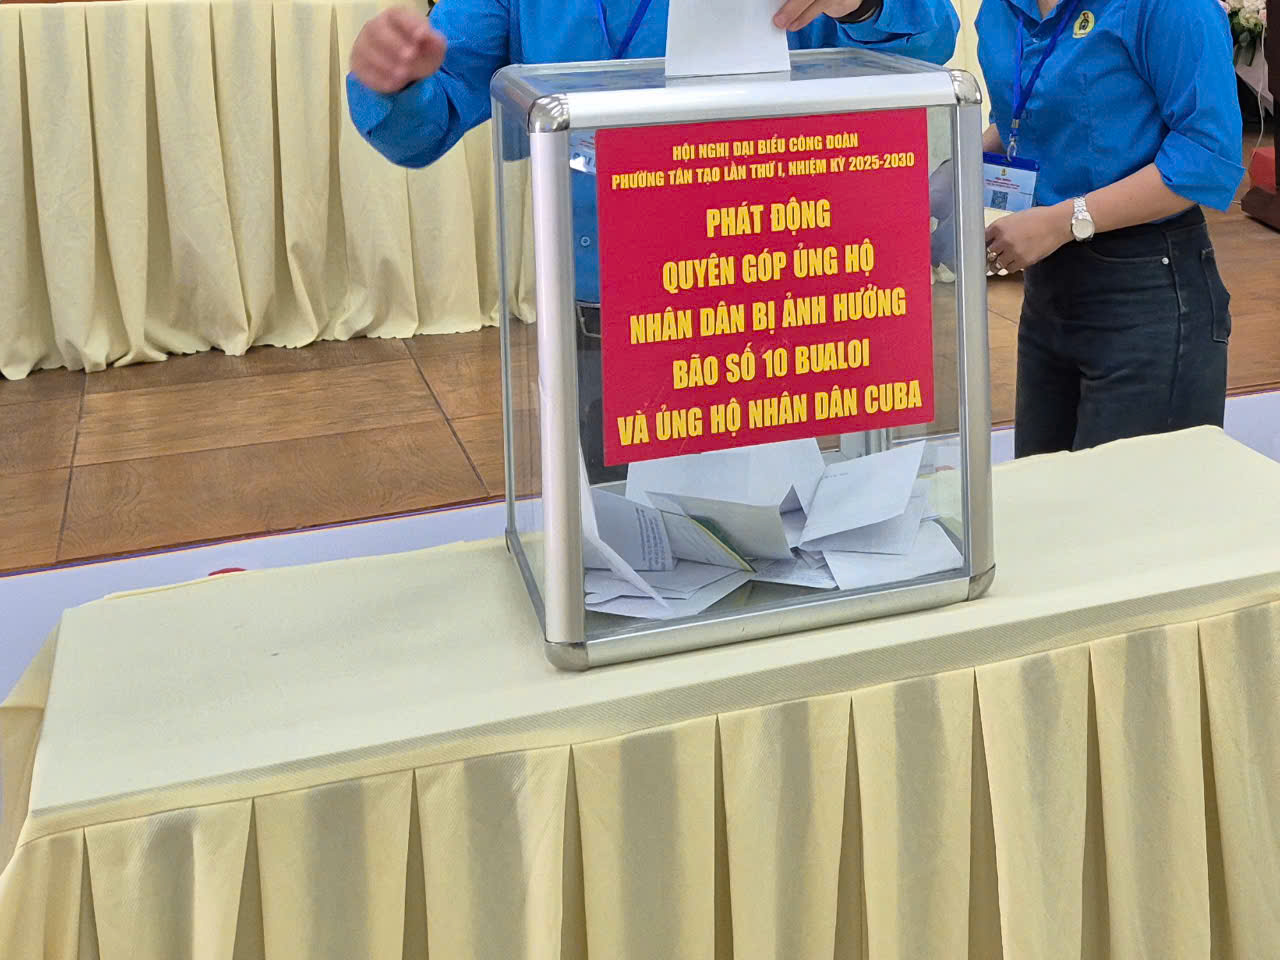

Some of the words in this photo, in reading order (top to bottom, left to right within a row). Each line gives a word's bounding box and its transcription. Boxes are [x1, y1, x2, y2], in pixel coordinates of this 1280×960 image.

[611, 170, 664, 190] PHƯỜNG
[668, 167, 693, 185] TÂN
[696, 166, 721, 185] TẠO
[749, 161, 776, 179] THỨ
[788, 157, 827, 177] NHIỆM
[848, 152, 915, 171] 2025-2030
[673, 142, 694, 163] HỘI
[698, 142, 729, 159] NGHỊ
[757, 133, 786, 154] BIỂU
[789, 135, 822, 152] CÔNG
[706, 200, 764, 237] PHÁT
[770, 196, 831, 236] ĐỘNG
[662, 252, 735, 294] QUYÊN
[742, 248, 787, 284] GÓP
[793, 242, 838, 278] ỦNG
[845, 237, 874, 277] HỘ
[629, 306, 693, 345] NHÂN
[700, 301, 745, 337] DÂN
[752, 300, 775, 335] BỊ
[782, 292, 826, 328] ẢNH
[833, 283, 907, 321] HƯỞNG
[672, 354, 719, 389] BÃO
[725, 341, 756, 383] SỐ
[762, 349, 788, 379] 10
[795, 338, 870, 375] BUALOI
[617, 408, 650, 446] VÀ
[655, 403, 703, 440] ỦNG
[710, 397, 741, 437] HỘ
[748, 391, 808, 429] NHÂN
[814, 384, 858, 421] DÂN
[864, 379, 922, 415] CUBA
